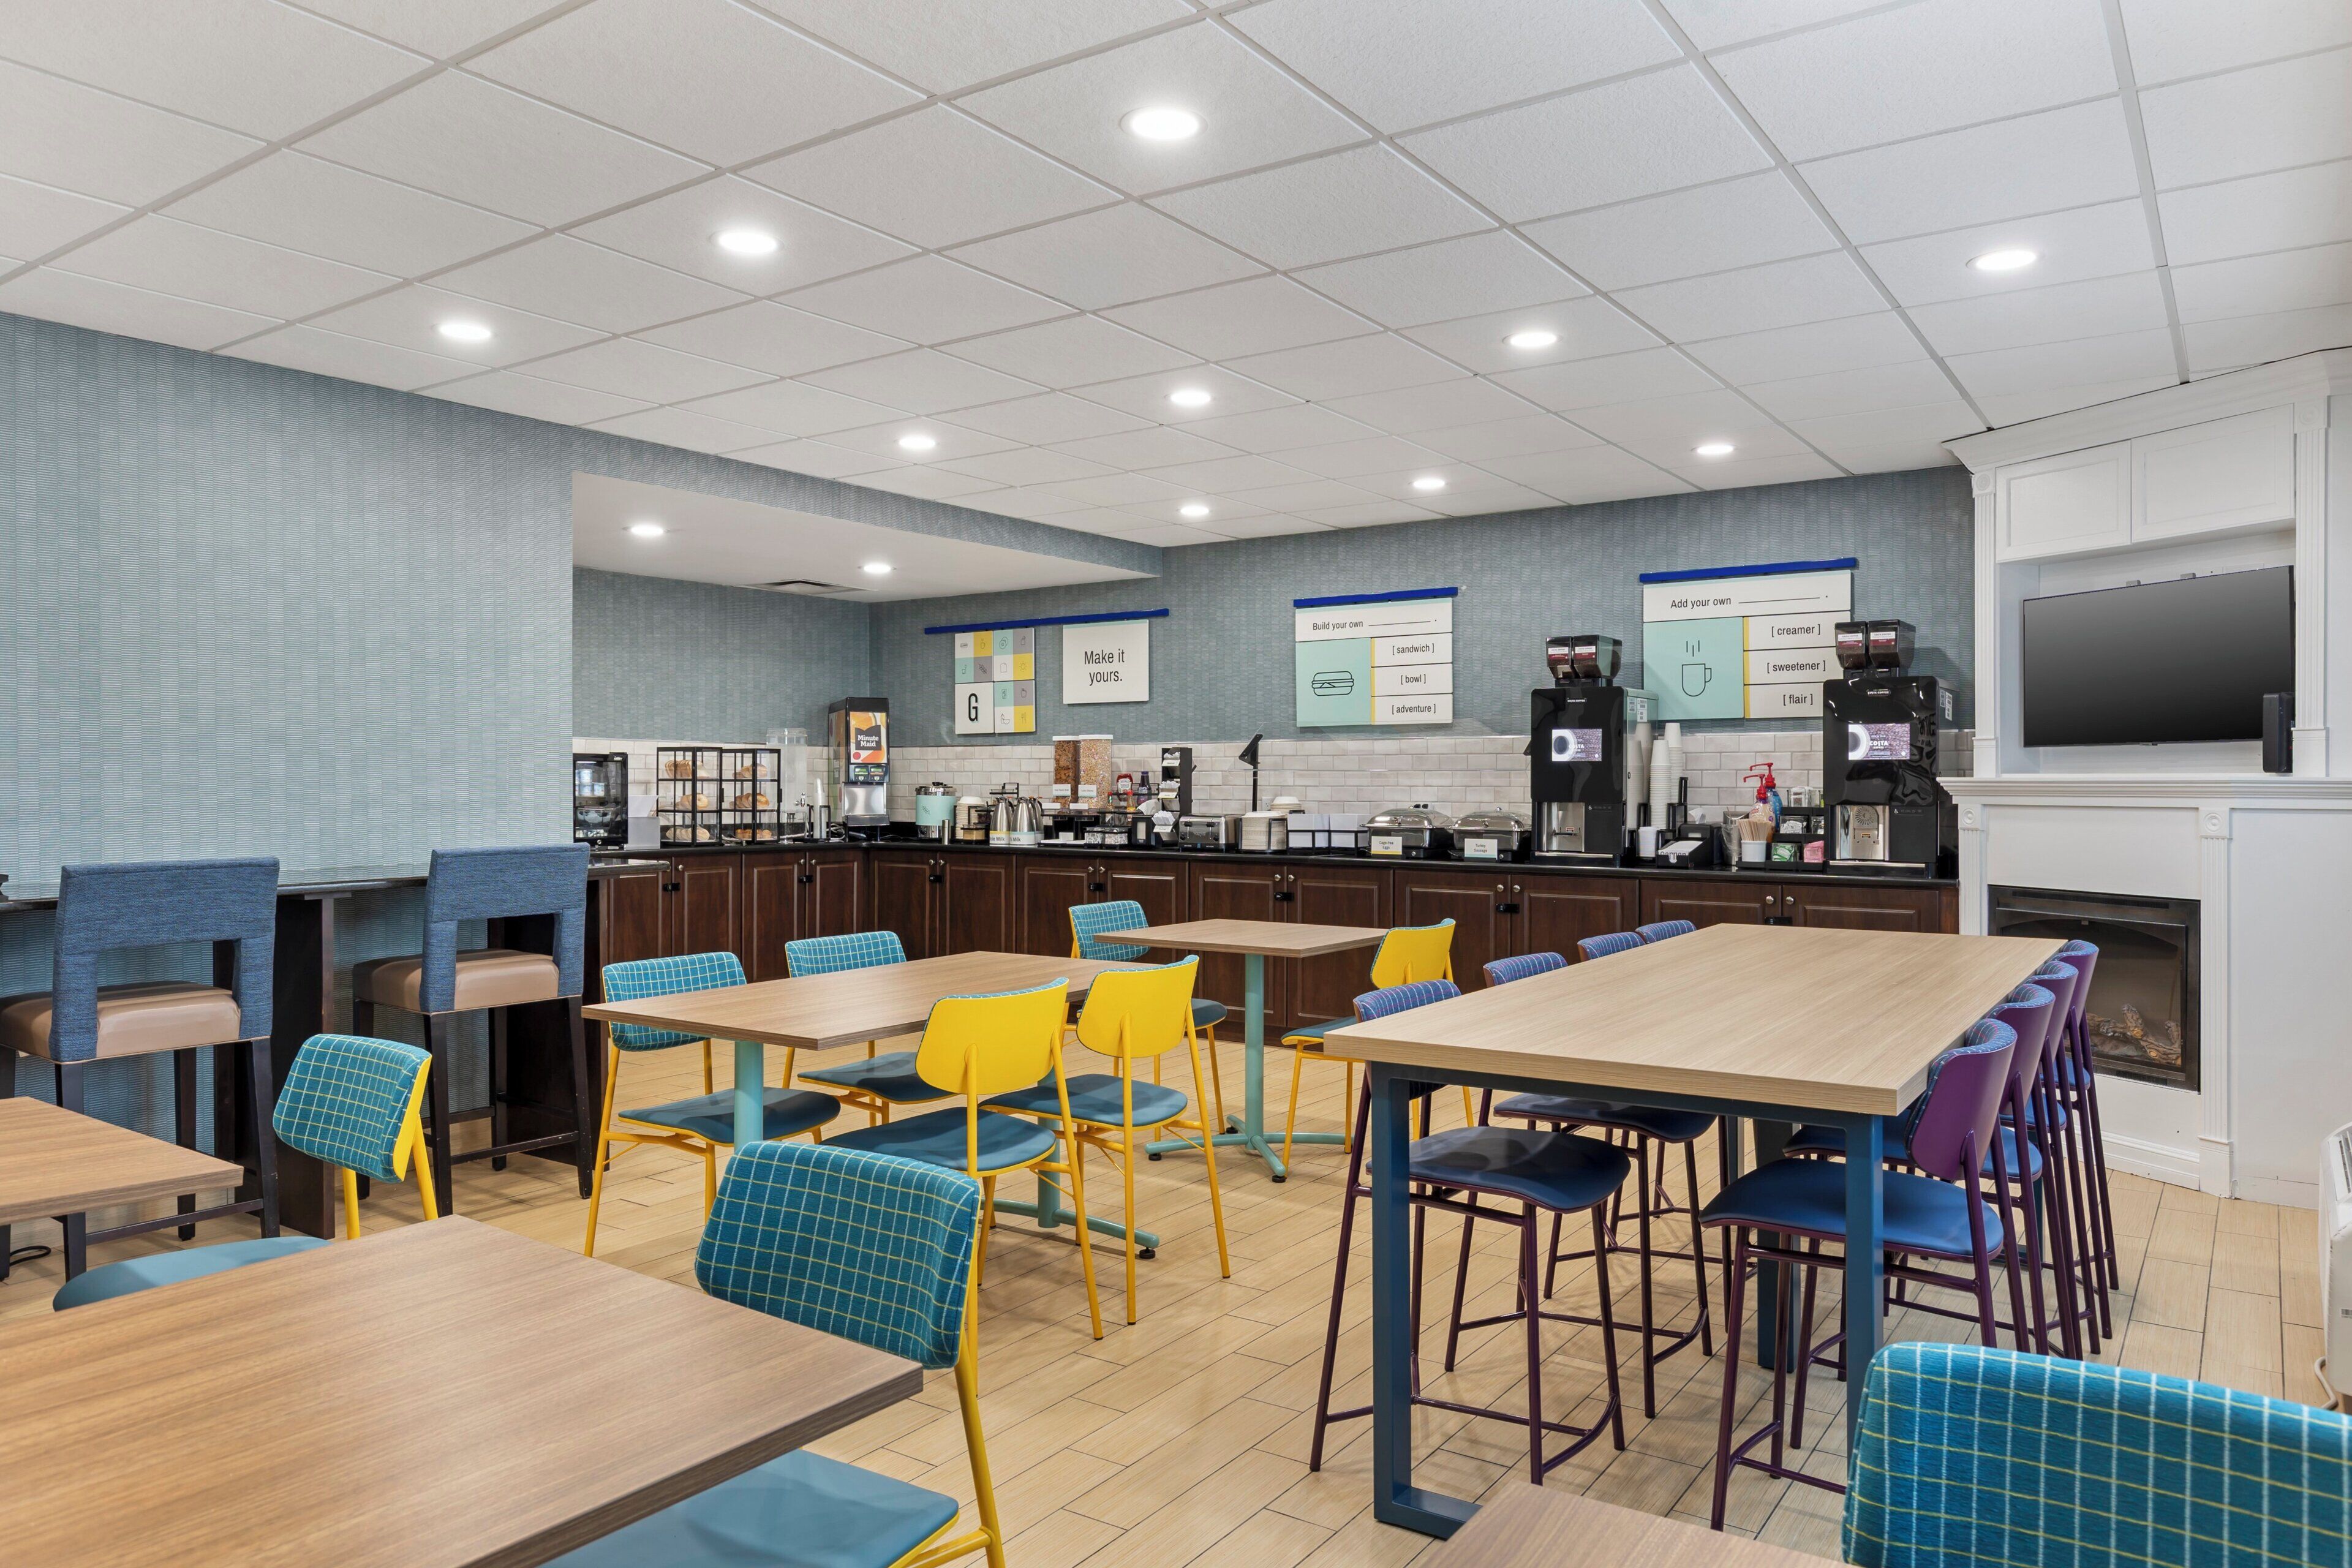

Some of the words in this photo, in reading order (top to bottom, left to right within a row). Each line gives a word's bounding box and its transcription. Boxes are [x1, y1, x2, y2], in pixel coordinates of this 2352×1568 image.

[1670, 598, 1688, 609] Add
[1691, 599, 1710, 609] your
[1313, 621, 1330, 630] Build
[1332, 622, 1347, 631] your
[1777, 626, 1815, 635] creamer
[1396, 644, 1430, 654] sandwich
[1084, 649, 1114, 665] Make
[1118, 648, 1125, 663] it
[1773, 662, 1820, 672] sweetener
[1089, 671, 1123, 686] yours.
[1405, 674, 1422, 683] bowl
[1789, 694, 1807, 704] flair
[968, 693, 978, 722] G
[1396, 704, 1431, 713] adventure
